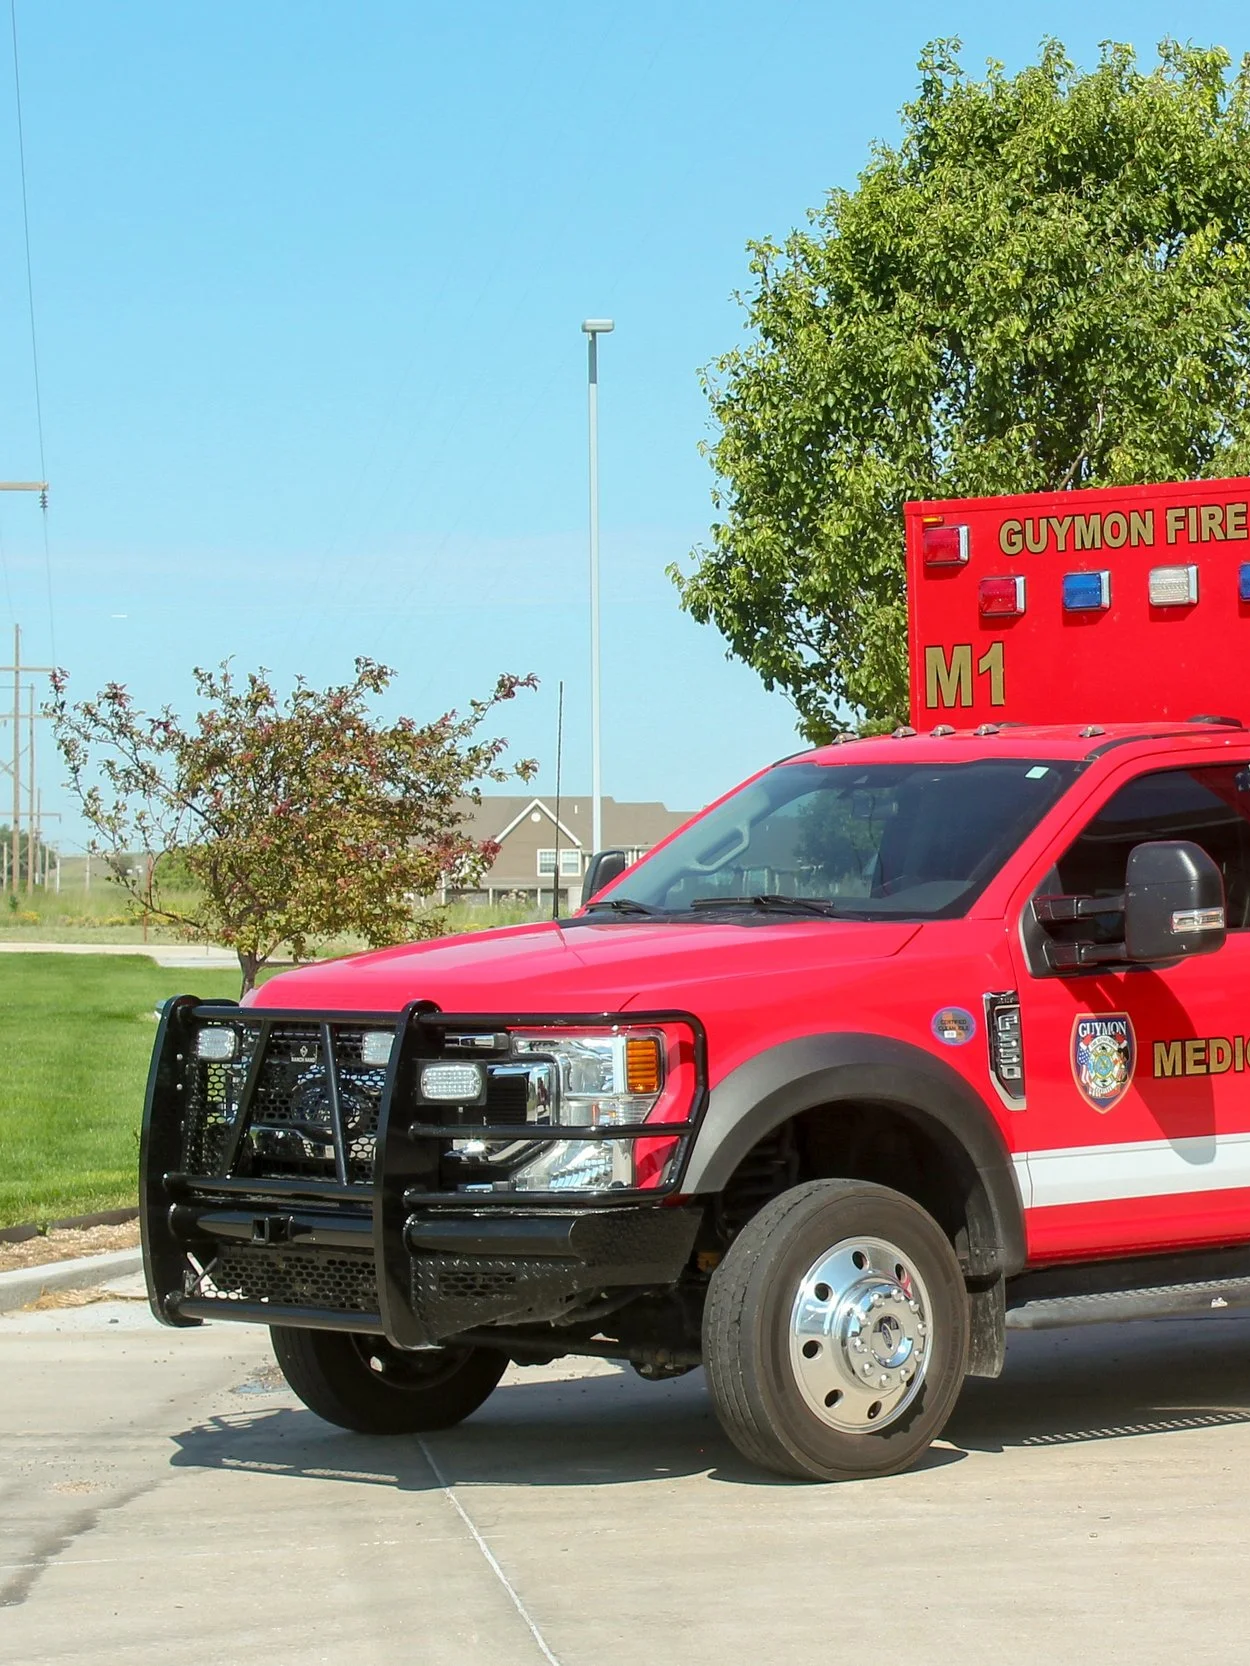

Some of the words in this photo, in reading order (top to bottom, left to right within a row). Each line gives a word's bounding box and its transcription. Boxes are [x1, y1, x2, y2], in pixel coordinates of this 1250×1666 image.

[998, 509, 1155, 556] GUYMON
[1165, 502, 1249, 545] FIRE
[924, 641, 1006, 709] M1
[1078, 1021, 1127, 1037] GUYMON
